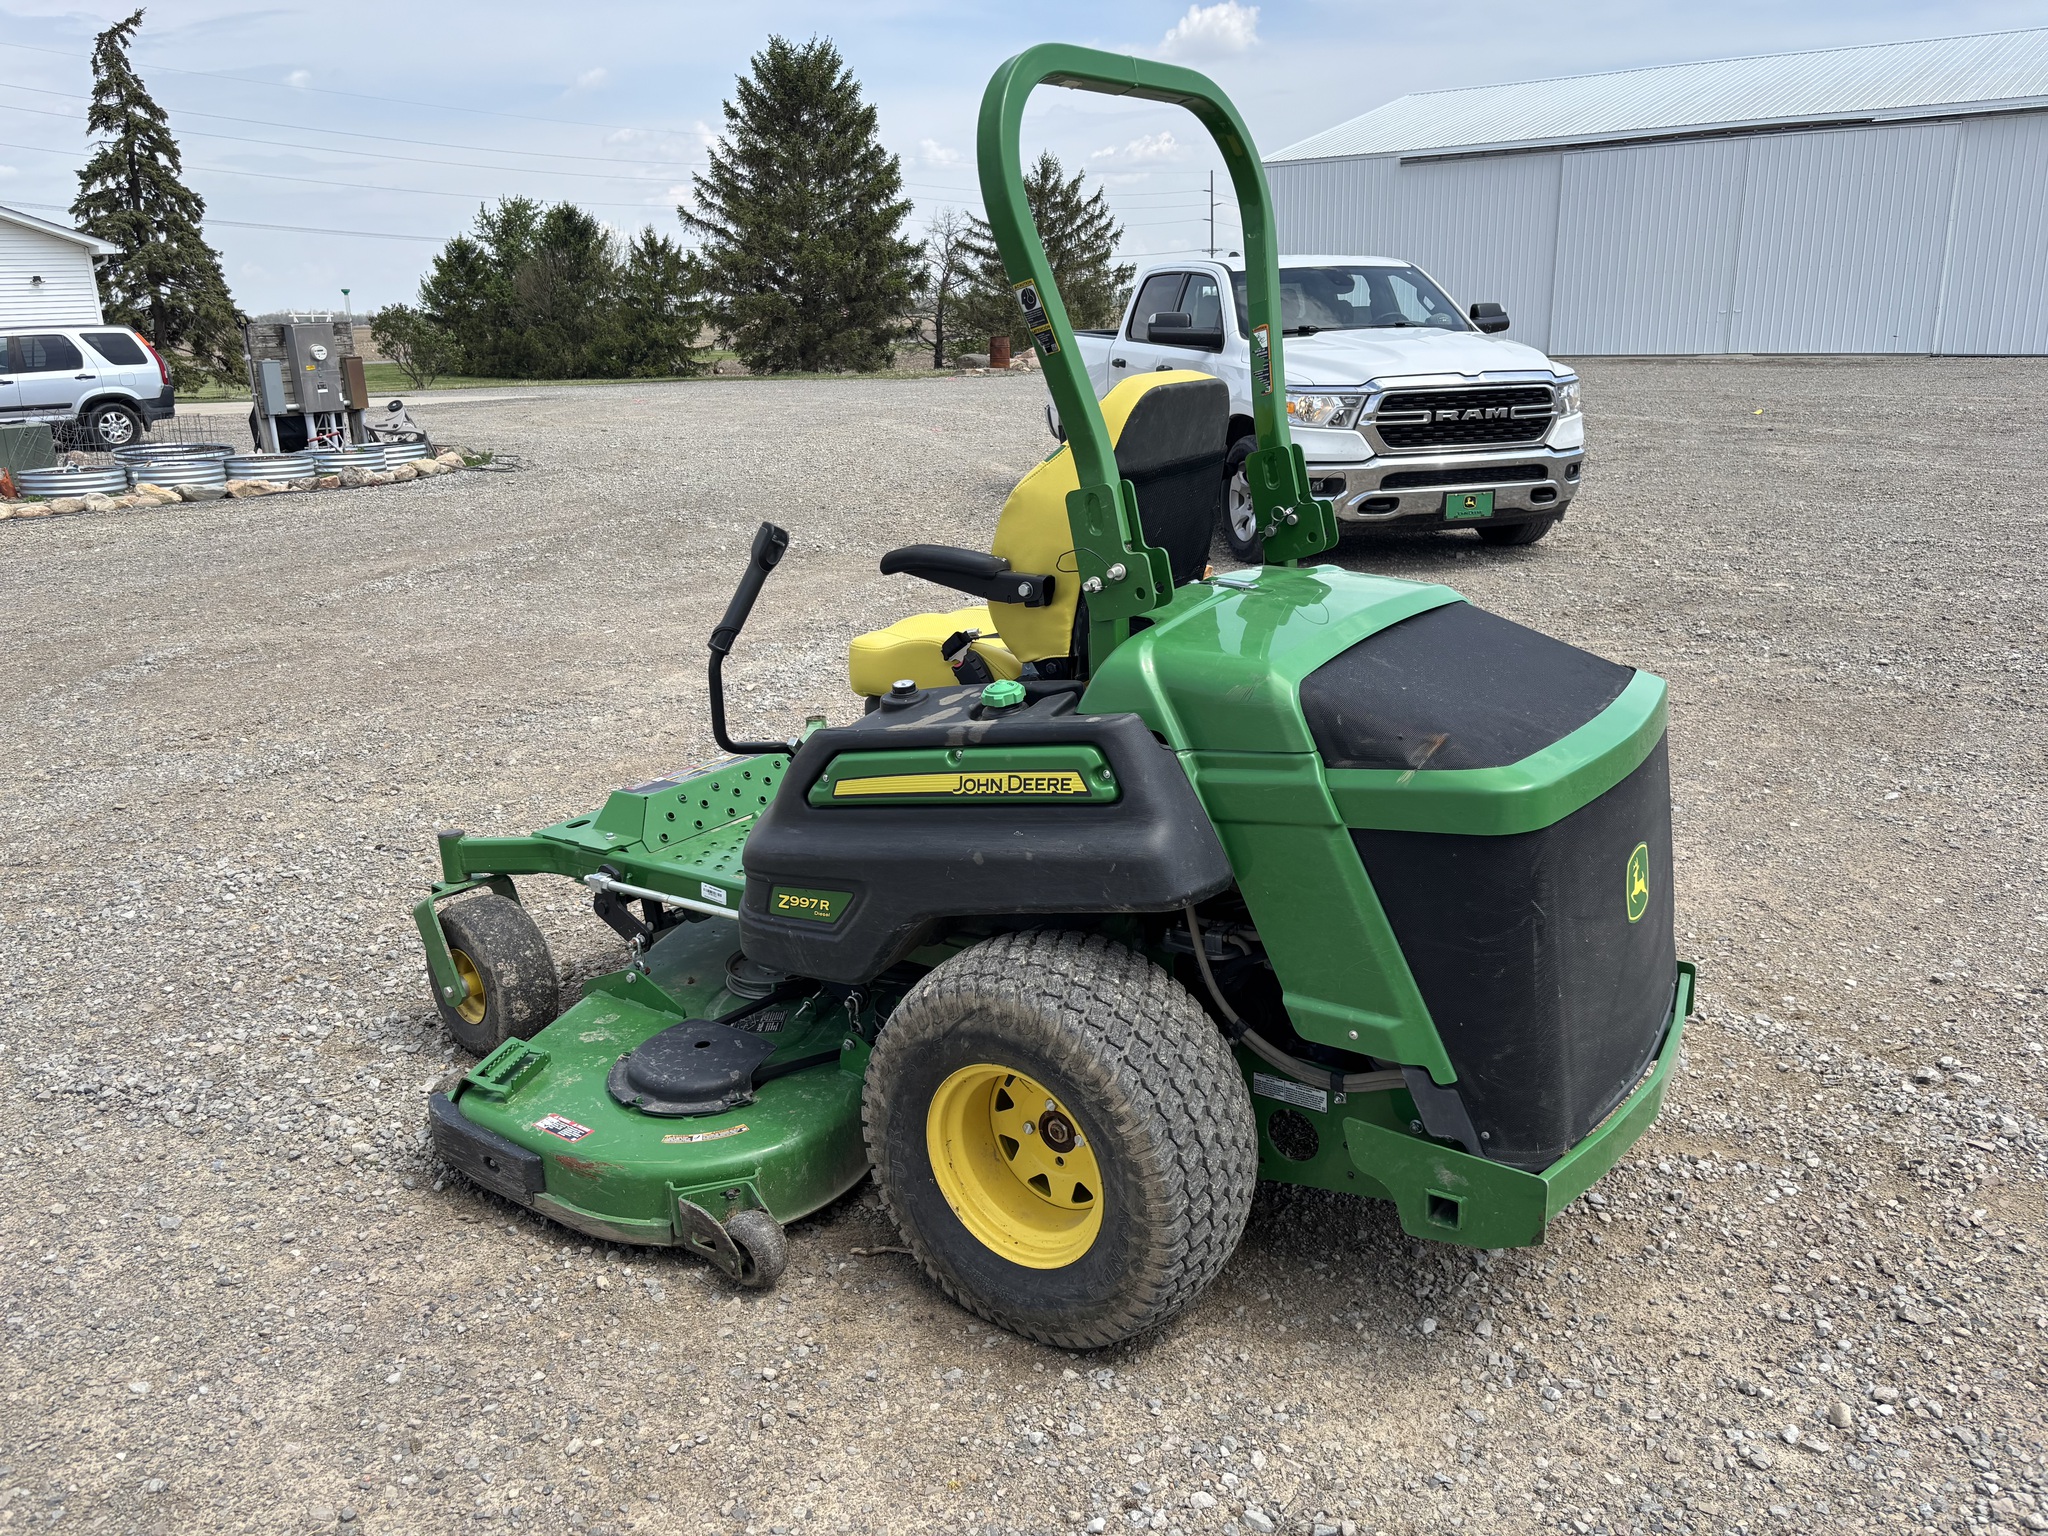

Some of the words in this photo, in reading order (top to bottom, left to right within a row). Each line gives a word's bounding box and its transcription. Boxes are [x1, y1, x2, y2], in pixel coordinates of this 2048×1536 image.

[1435, 407, 1508, 421] RAM
[952, 775, 1003, 793] JOHN
[1007, 774, 1074, 793] DEERE
[1086, 1205, 1131, 1301] KENDA
